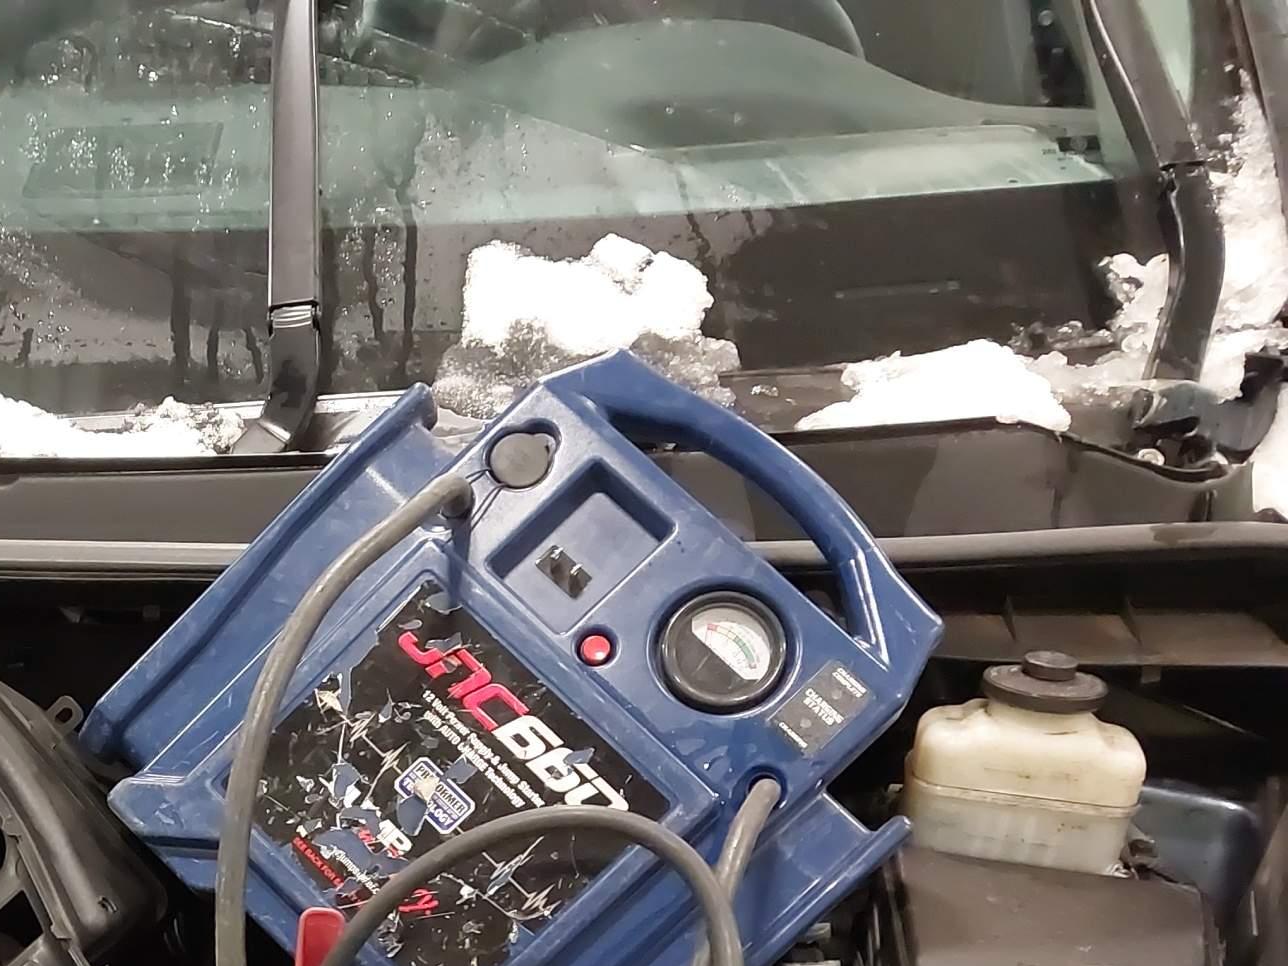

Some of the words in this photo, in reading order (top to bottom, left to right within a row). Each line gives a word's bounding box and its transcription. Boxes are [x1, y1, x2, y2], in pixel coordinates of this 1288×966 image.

[803, 697, 833, 724] STATUS
[805, 688, 843, 723] CHARGING
[422, 689, 434, 702] 12
[431, 698, 448, 715] Volt
[444, 711, 470, 736] Power
[496, 762, 519, 785] Jump
[424, 709, 442, 727] with
[439, 724, 460, 744] AUTO
[483, 767, 525, 808] Technology
[402, 778, 451, 825] TEOLOGY
[416, 765, 465, 812] PRORMER
